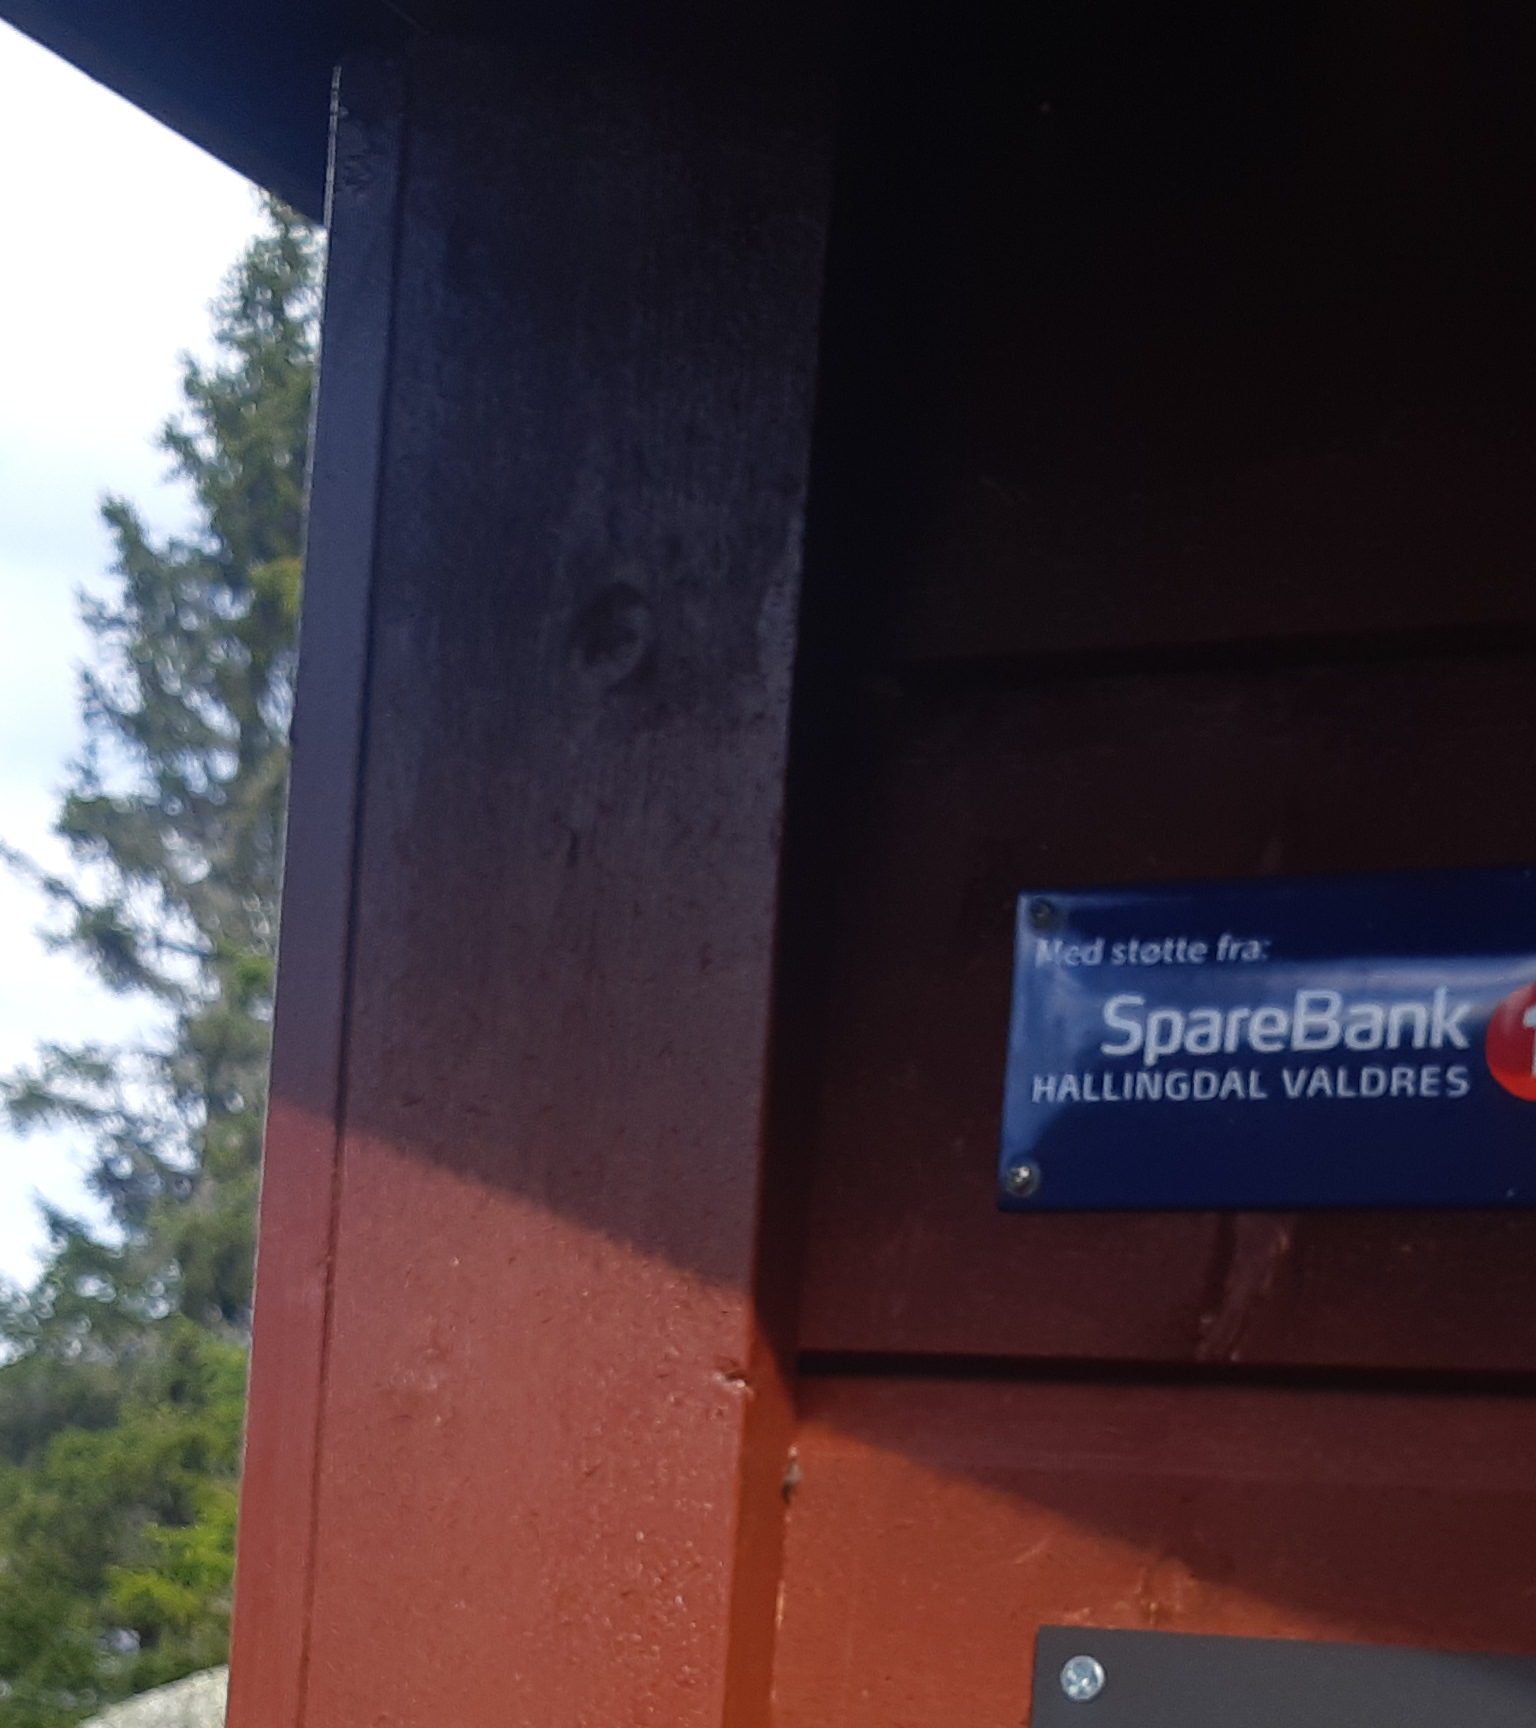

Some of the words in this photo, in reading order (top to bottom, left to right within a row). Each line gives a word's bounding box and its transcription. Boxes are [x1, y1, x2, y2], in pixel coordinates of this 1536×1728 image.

[1035, 937, 1102, 967] Med
[1111, 937, 1207, 965] støtte
[1101, 985, 1470, 1066] SpareBank
[1031, 1069, 1268, 1103] HALLINGDAL
[1282, 1066, 1470, 1098] VALDRES
